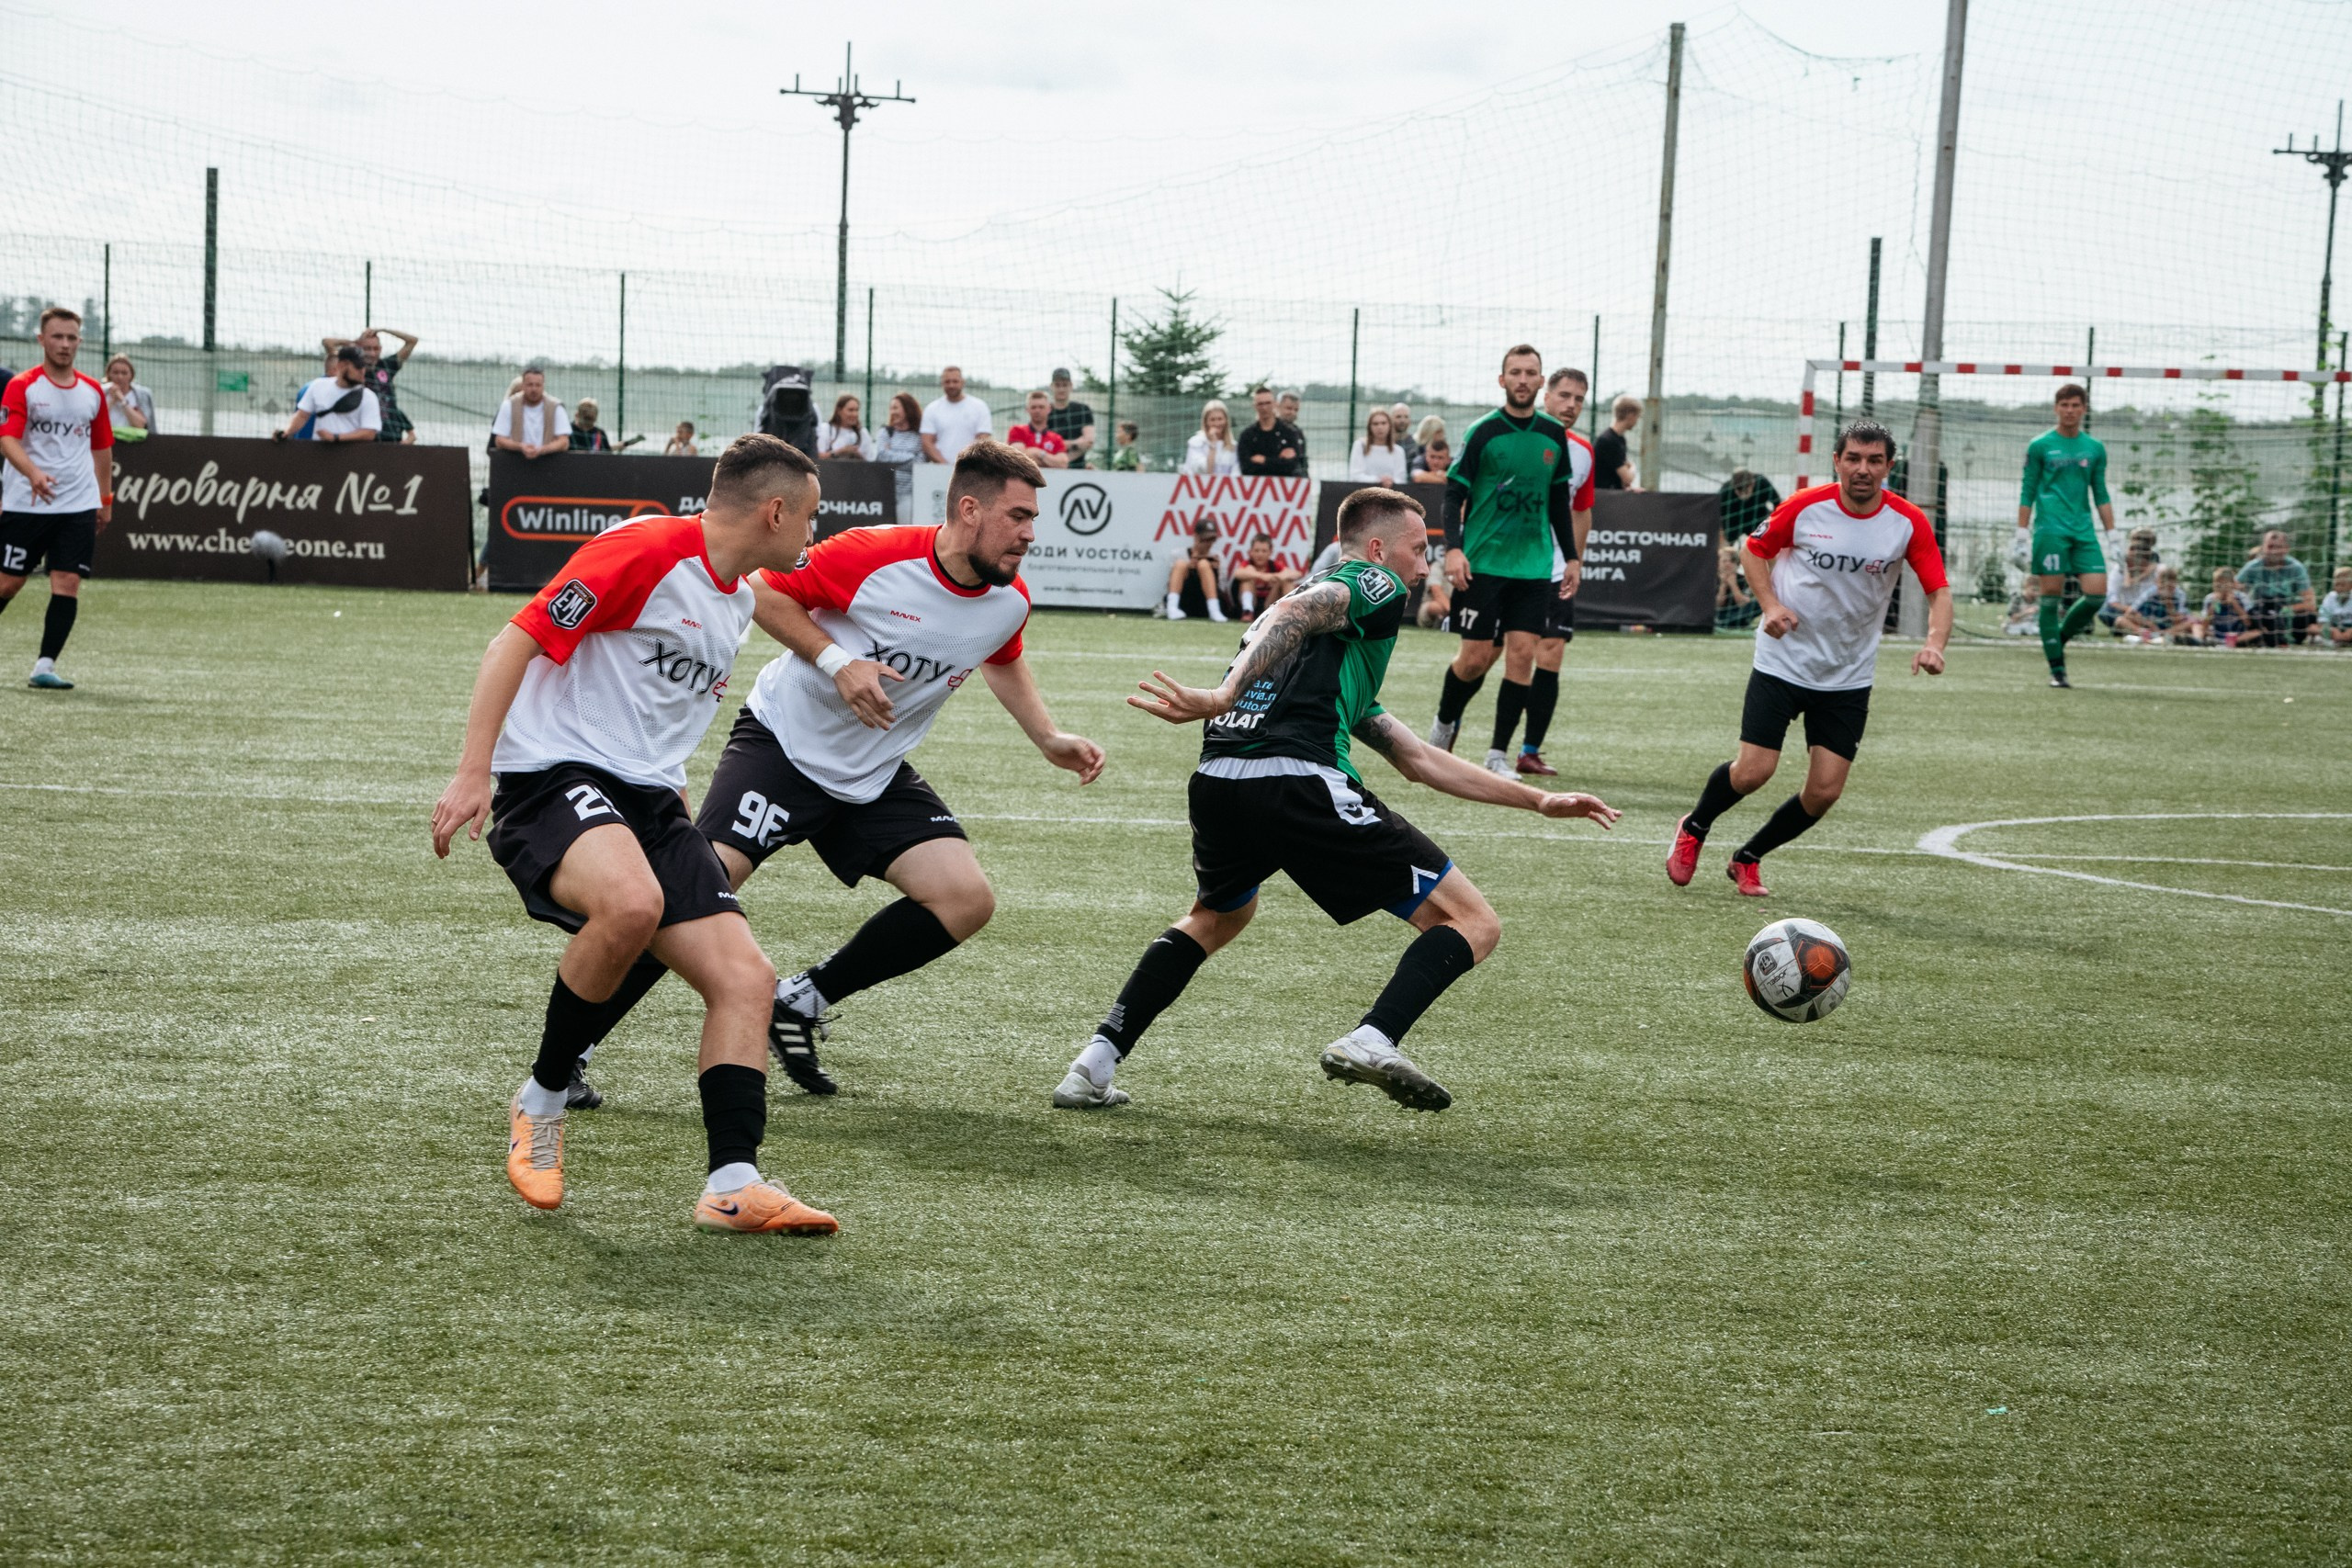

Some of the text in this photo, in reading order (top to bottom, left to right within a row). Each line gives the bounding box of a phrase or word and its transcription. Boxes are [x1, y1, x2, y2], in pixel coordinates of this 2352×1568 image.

[127, 528, 387, 559] www.cheeone.ru
[1586, 529, 1707, 547] ВОСТОЧНАЯ
[3, 544, 28, 571] 12
[1029, 546, 1068, 558] ЮДИ
[2042, 553, 2060, 571] 41
[889, 609, 922, 623] MAVEX
[1459, 607, 1479, 630] 17
